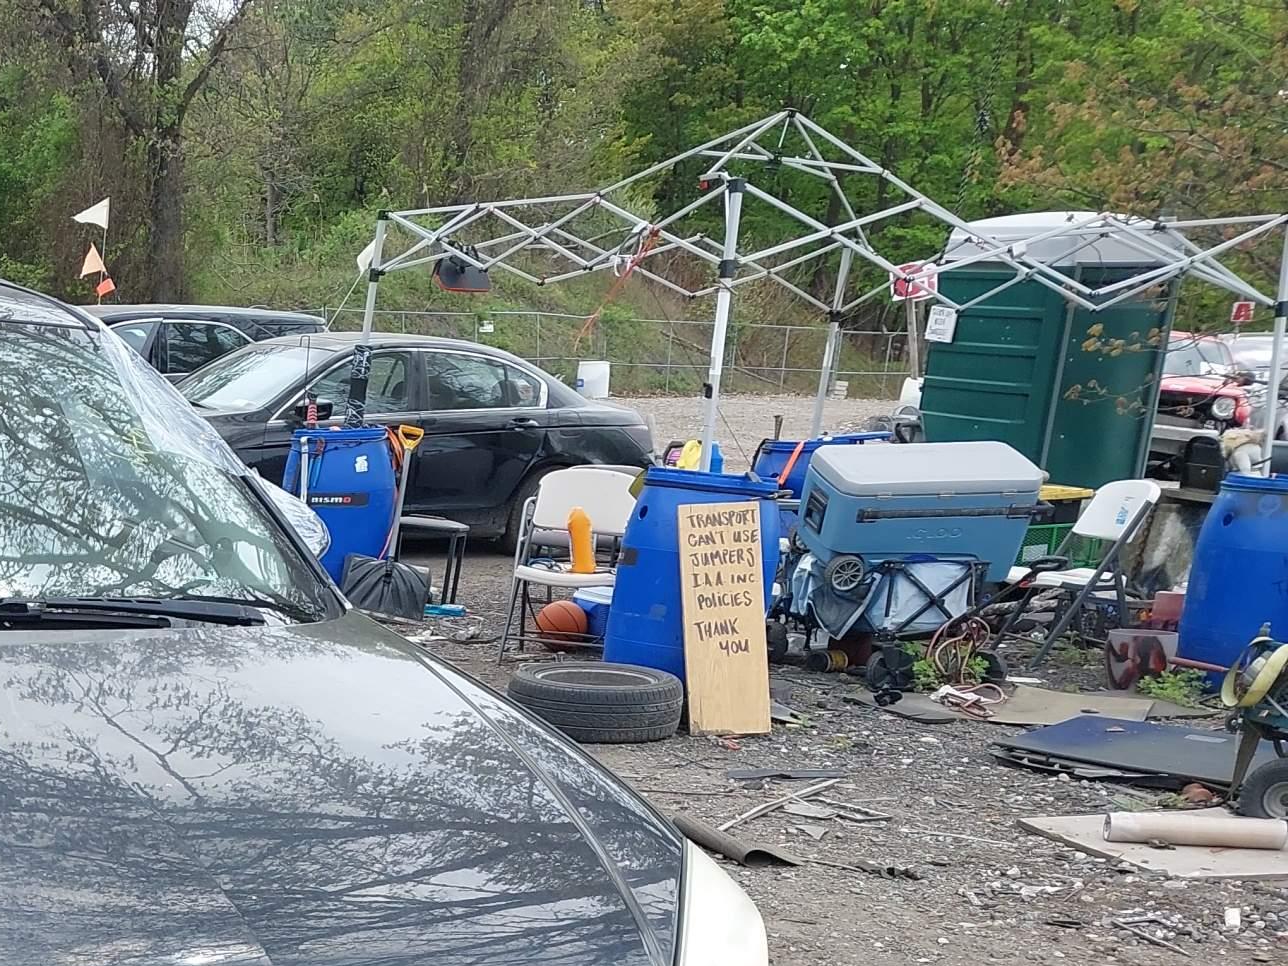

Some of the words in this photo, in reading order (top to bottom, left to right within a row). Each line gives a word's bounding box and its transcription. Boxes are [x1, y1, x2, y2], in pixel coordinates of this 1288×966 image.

[687, 509, 757, 528] TRANSPORT
[733, 528, 759, 543] USE
[689, 547, 755, 567] JUMPERS
[693, 617, 739, 641] THANK
